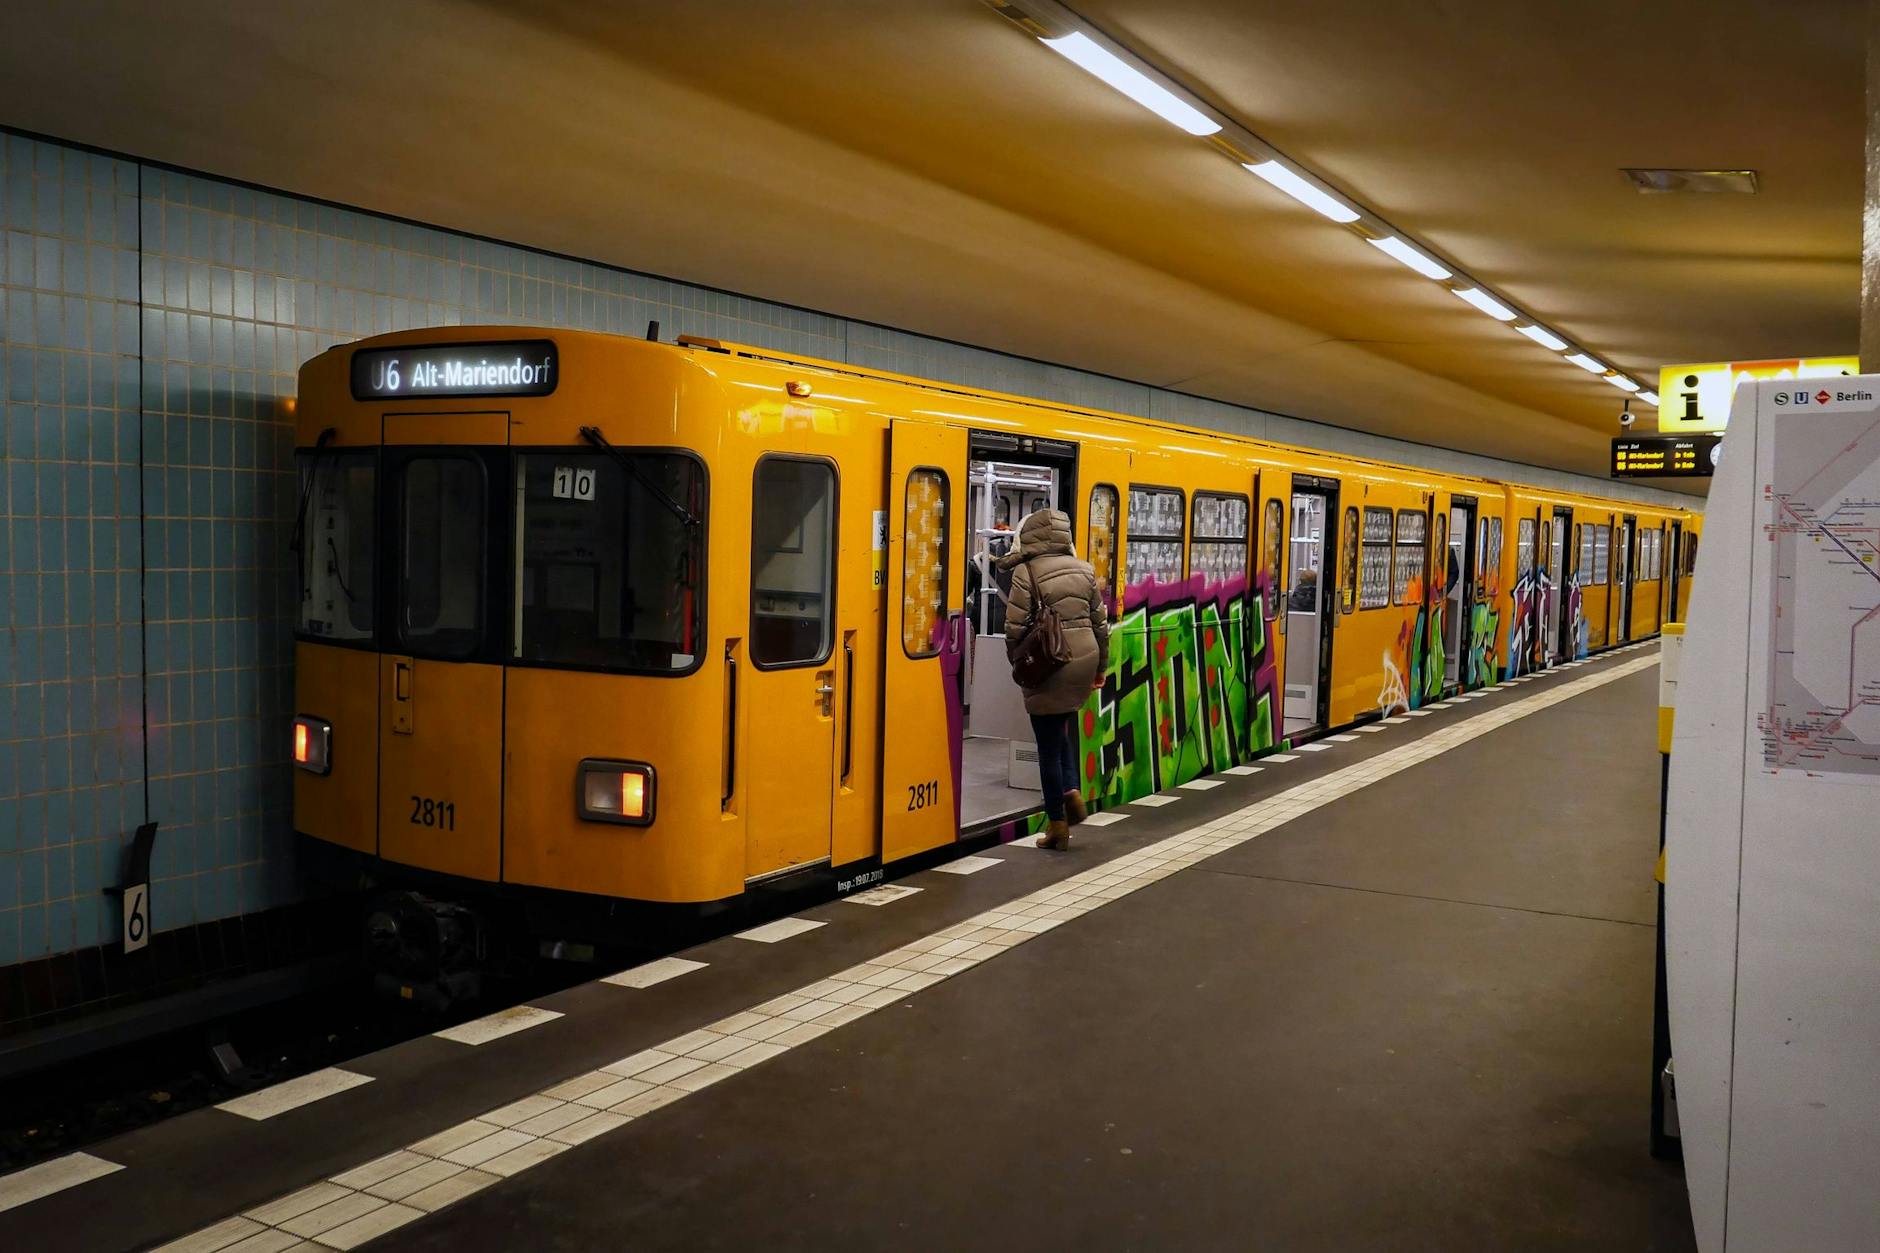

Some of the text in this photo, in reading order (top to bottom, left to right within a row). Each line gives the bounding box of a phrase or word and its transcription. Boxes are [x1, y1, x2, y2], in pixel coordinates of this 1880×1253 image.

[371, 357, 550, 391] U6 Alt-Mariendorf
[1837, 390, 1872, 401] Berlin
[559, 474, 590, 496] 10
[907, 780, 938, 812] 2811
[410, 795, 455, 832] 2811
[128, 892, 144, 942] 6
